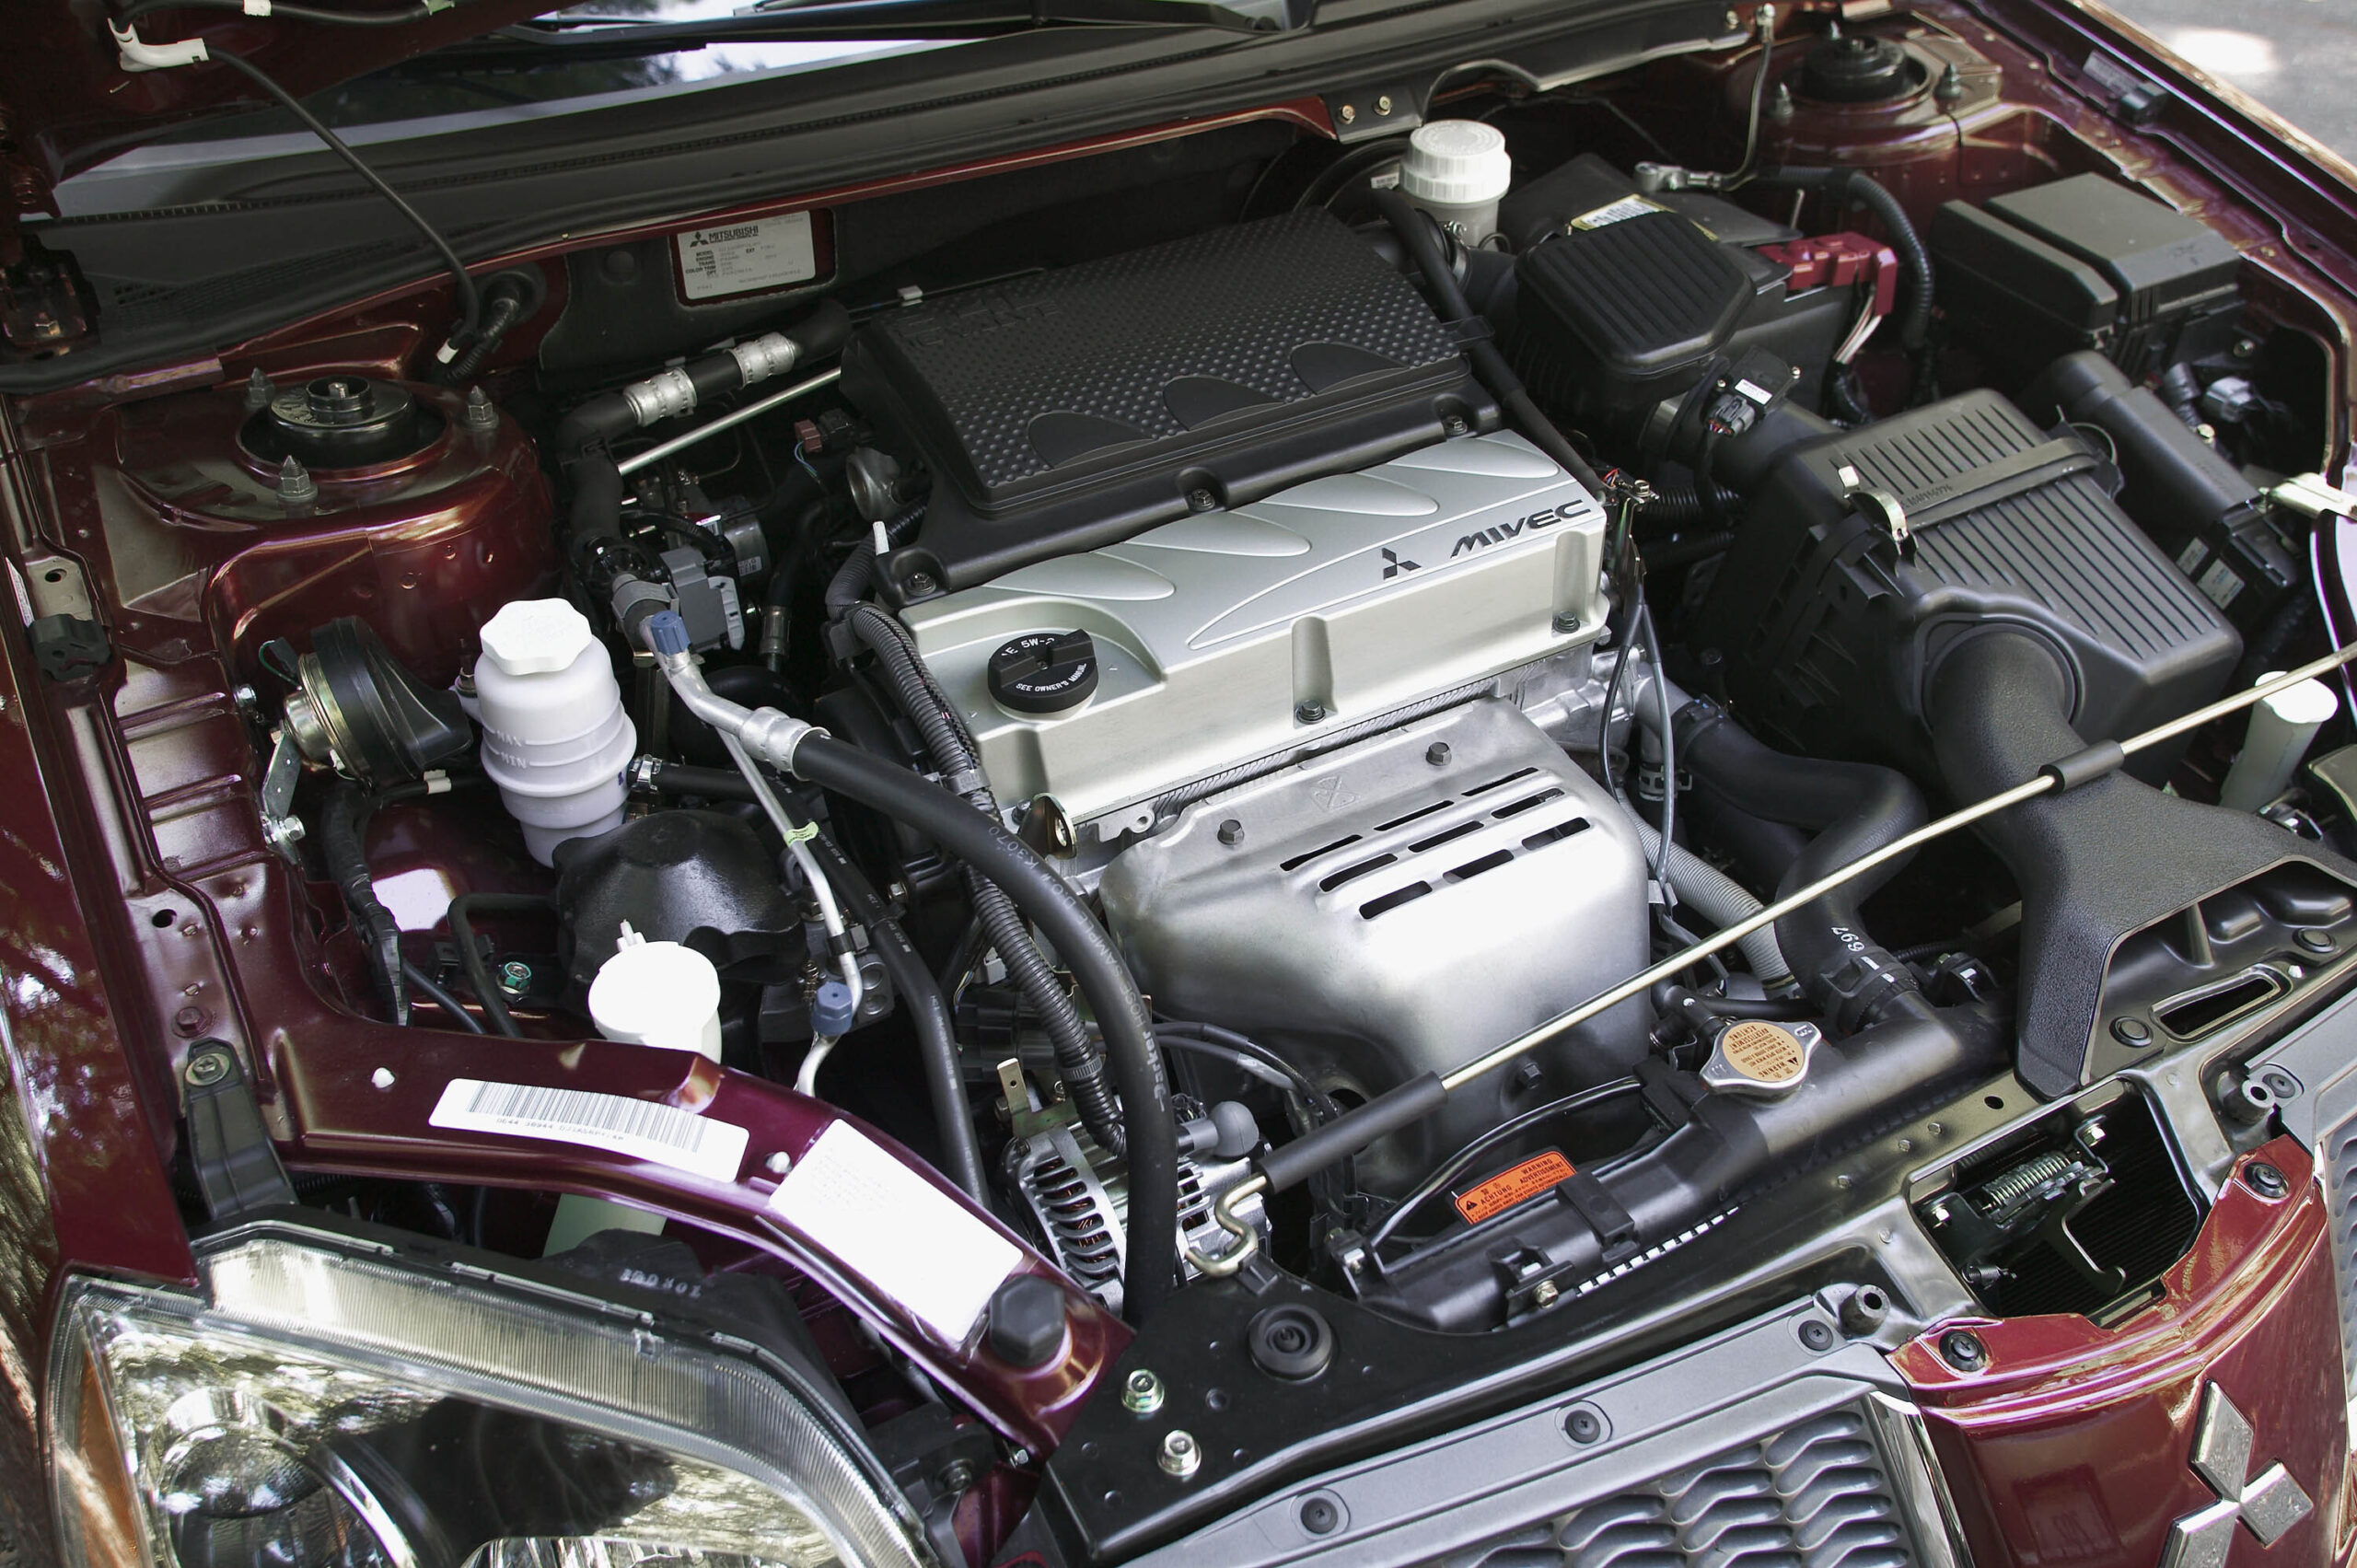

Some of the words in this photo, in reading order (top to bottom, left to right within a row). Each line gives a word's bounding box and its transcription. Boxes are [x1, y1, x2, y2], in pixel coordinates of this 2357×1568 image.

[709, 226, 759, 240] MITSUBISHI
[1451, 499, 1591, 558] MIVEC
[1016, 683, 1032, 691] SEE
[1035, 680, 1069, 692] OWNER'S
[1068, 663, 1087, 682] MANUAL
[497, 730, 523, 747] MAX
[501, 752, 527, 769] MIN
[988, 826, 1039, 869] K3070
[1078, 915, 1123, 980] SAMPLE
[1831, 927, 1864, 951] 697
[1521, 1158, 1553, 1175] WARNING
[1480, 1184, 1513, 1205] ACHTUNG
